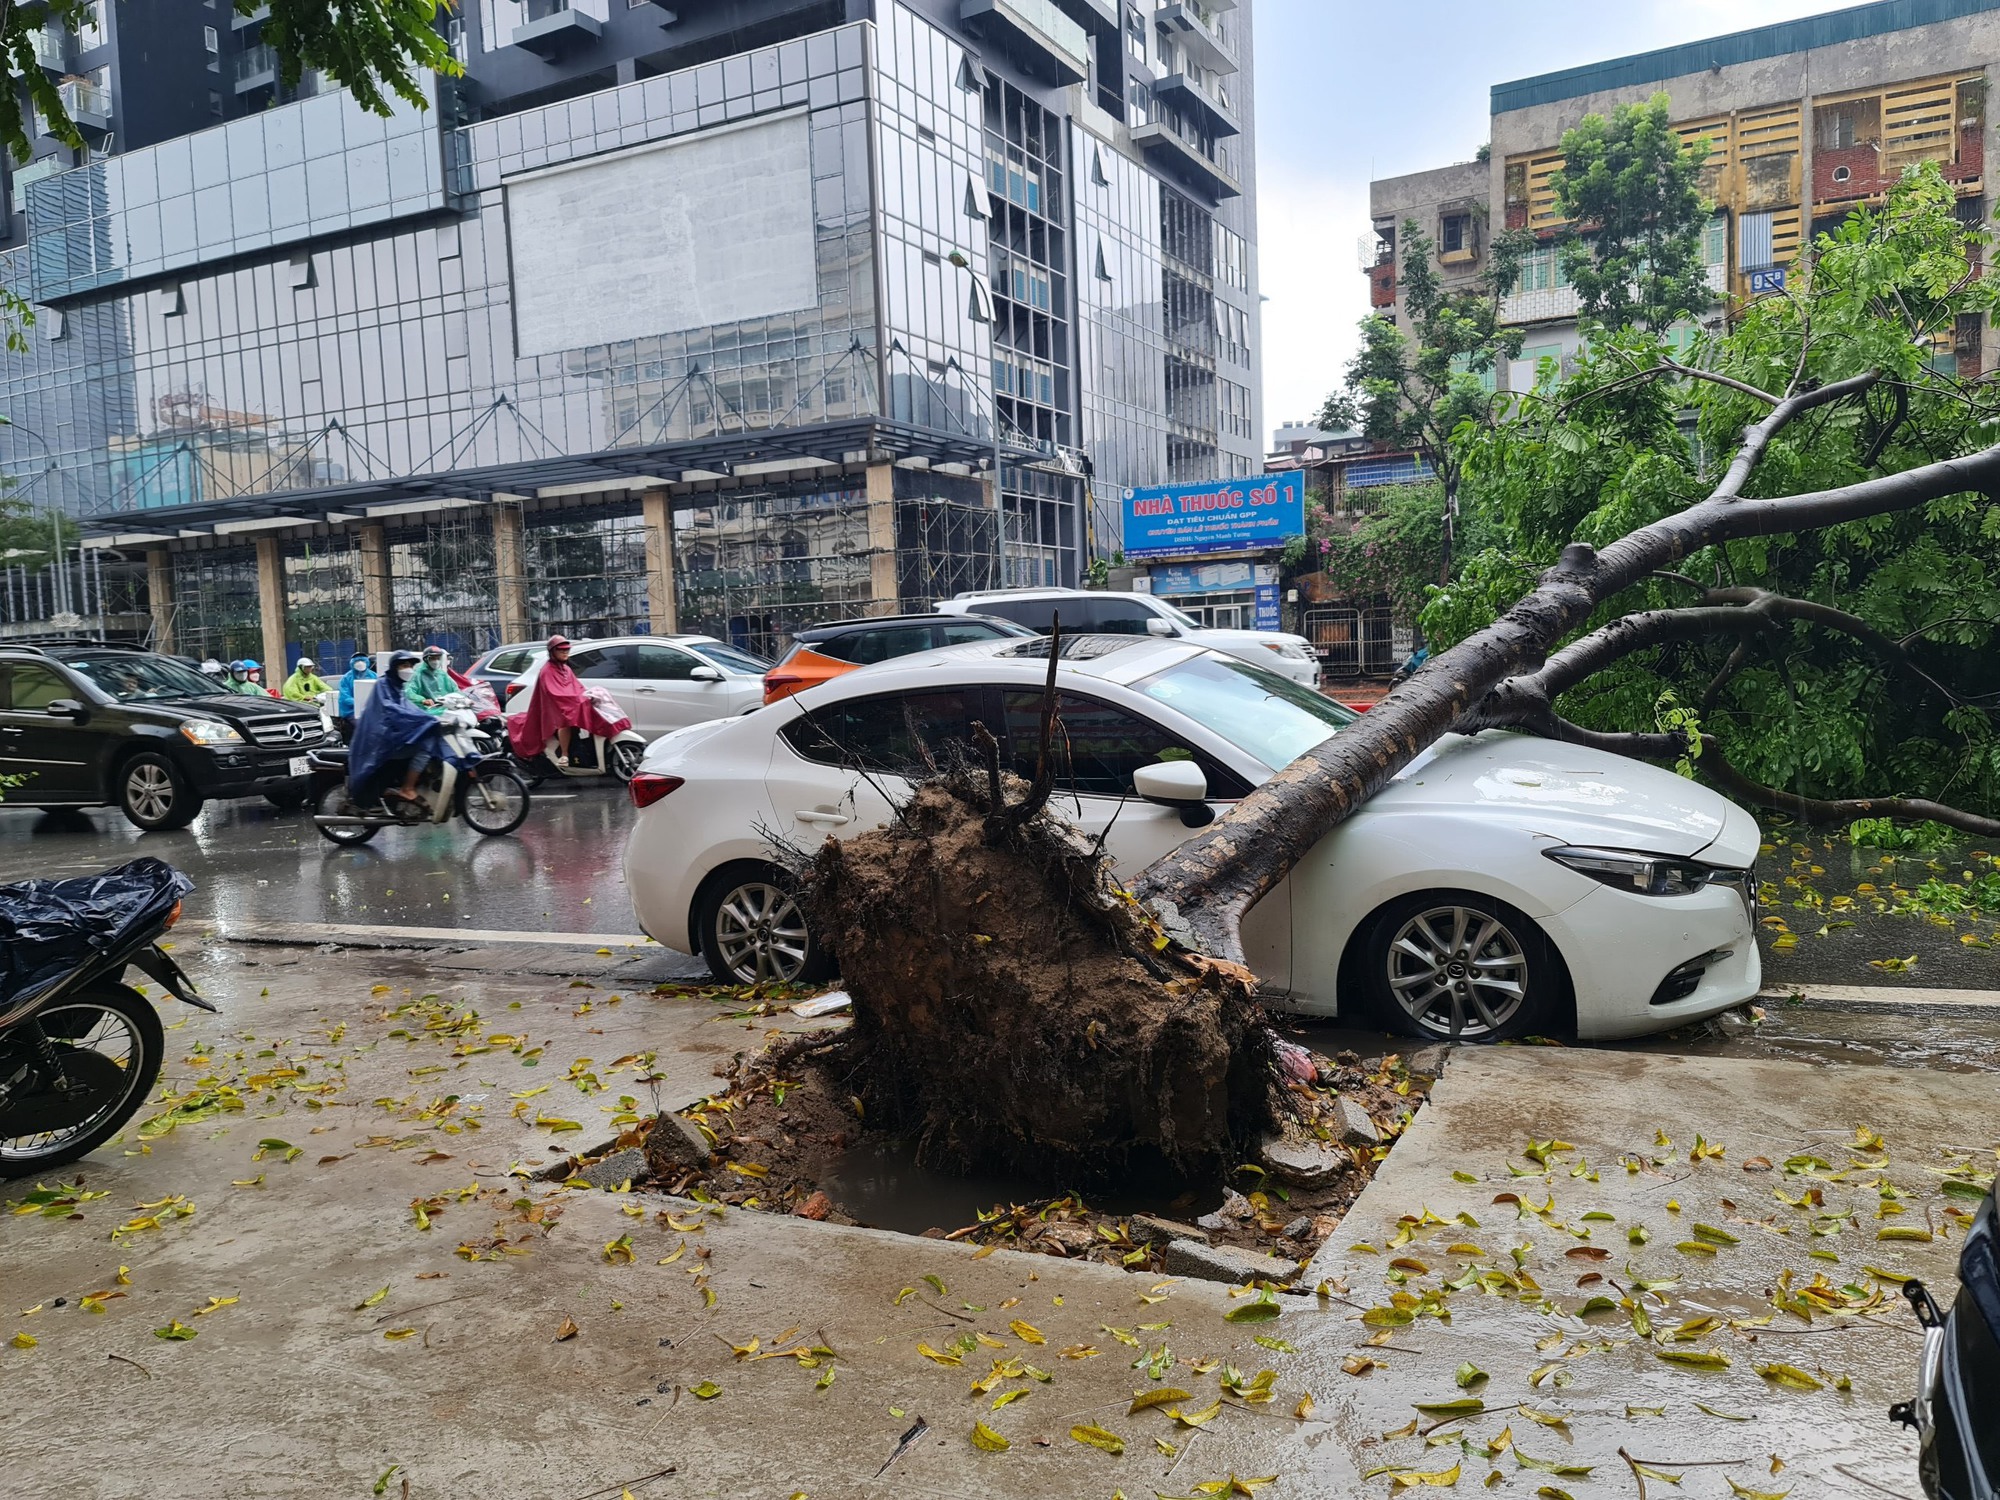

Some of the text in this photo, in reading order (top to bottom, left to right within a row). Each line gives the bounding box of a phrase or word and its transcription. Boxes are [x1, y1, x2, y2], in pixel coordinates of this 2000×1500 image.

[1134, 481, 1294, 517] NHÀ THUỐC SỐ 1
[1186, 514, 1205, 523] TIÊU
